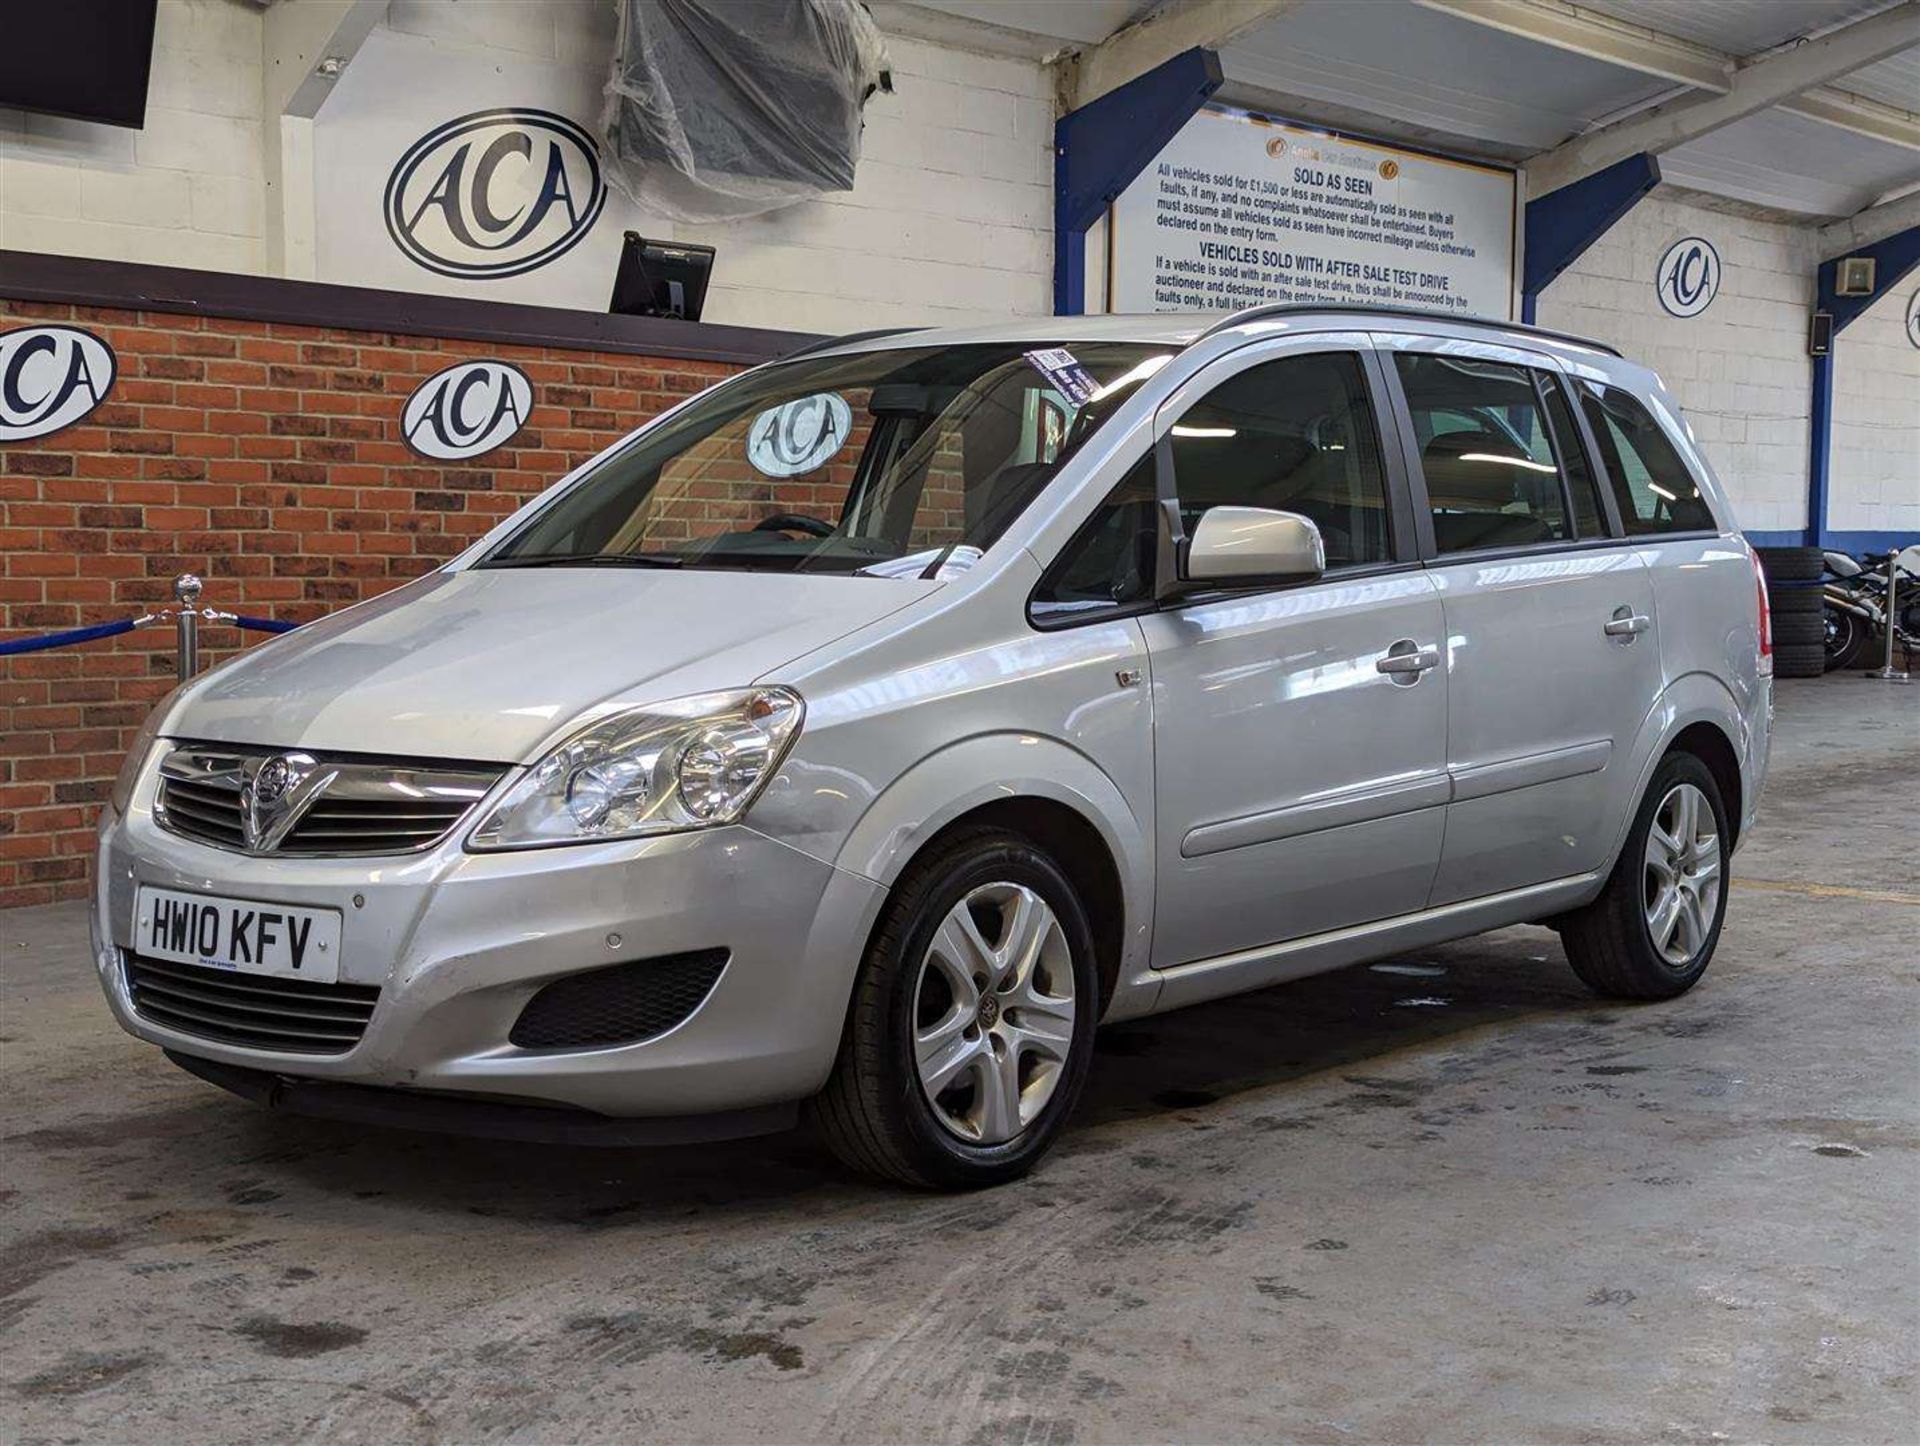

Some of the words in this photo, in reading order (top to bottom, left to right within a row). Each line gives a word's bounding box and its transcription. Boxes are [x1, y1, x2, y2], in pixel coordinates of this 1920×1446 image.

[405, 131, 580, 250] ACA
[1157, 163, 1170, 176] All
[1172, 167, 1211, 184] vehicles
[1213, 174, 1232, 187] sold
[1235, 176, 1248, 190] for
[1280, 187, 1289, 196] or
[1291, 187, 1309, 200] less
[1311, 192, 1323, 202] are
[1325, 195, 1378, 214] automatically
[1380, 204, 1396, 215] sold
[1398, 207, 1407, 217] as
[1409, 209, 1426, 220] seen
[1428, 211, 1443, 223] with
[1445, 214, 1454, 225] all
[1160, 180, 1188, 198] faults,
[1191, 185, 1198, 197] if
[1200, 189, 1219, 204] any,
[1221, 192, 1238, 204] and
[1240, 196, 1251, 207] no
[1254, 198, 1300, 215] complaints
[1302, 205, 1348, 221] whatsoever
[1350, 213, 1369, 225] shall
[1371, 216, 1381, 227] be
[1429, 225, 1454, 240] Buyers
[1294, 167, 1324, 186] SOLD
[1326, 174, 1341, 190] AS
[1344, 176, 1373, 196] SEEN
[1157, 214, 1198, 230] declared
[1200, 222, 1211, 232] on
[1214, 222, 1229, 235] the
[1230, 226, 1254, 242] entry
[1256, 228, 1279, 242] form.
[1157, 199, 1181, 212] must
[1183, 202, 1219, 218] assume
[1221, 207, 1232, 219] all
[1234, 210, 1271, 225] vehicles
[1272, 216, 1290, 229] sold
[1293, 220, 1303, 231] as
[1304, 222, 1324, 233] seen
[1326, 223, 1345, 237] have
[1347, 227, 1382, 243] incorrect
[1384, 234, 1413, 249] mileage
[1415, 240, 1439, 252] unless
[1440, 243, 1475, 258] otherwise
[1155, 274, 1205, 290] auctioneer
[1207, 280, 1224, 294] and
[1226, 282, 1264, 297] declared
[1266, 288, 1278, 298] on
[1279, 289, 1293, 300] the
[1156, 256, 1163, 268] If
[1165, 259, 1171, 269] a
[1173, 260, 1206, 274] vehicle
[1208, 262, 1216, 276] is
[1219, 266, 1238, 278] sold
[1240, 269, 1259, 281] with
[1261, 272, 1272, 282] an
[1274, 273, 1293, 285] after
[1295, 276, 1312, 287] sale
[1314, 277, 1329, 290] test
[1355, 283, 1370, 295] this
[1372, 286, 1391, 298] shall
[1393, 286, 1403, 299] be
[1404, 290, 1444, 304] announced
[1445, 294, 1455, 308] by
[1456, 296, 1468, 308] the
[1199, 241, 1259, 264] VEHICLES
[1262, 250, 1293, 269] SOLD
[1295, 255, 1323, 273] WITH
[1326, 259, 1360, 278] AFTER
[1363, 265, 1390, 283] SALE
[1393, 269, 1418, 286] TEST
[1420, 273, 1449, 290] DRIVE
[1661, 246, 1711, 306] ACA
[1155, 289, 1181, 304] faults
[1207, 298, 1213, 307] a
[1215, 296, 1230, 309] full
[0, 335, 99, 427] CA
[408, 368, 520, 447] ACA
[757, 398, 839, 465] ACA
[152, 898, 220, 957] HW10
[230, 909, 312, 969] KFV
